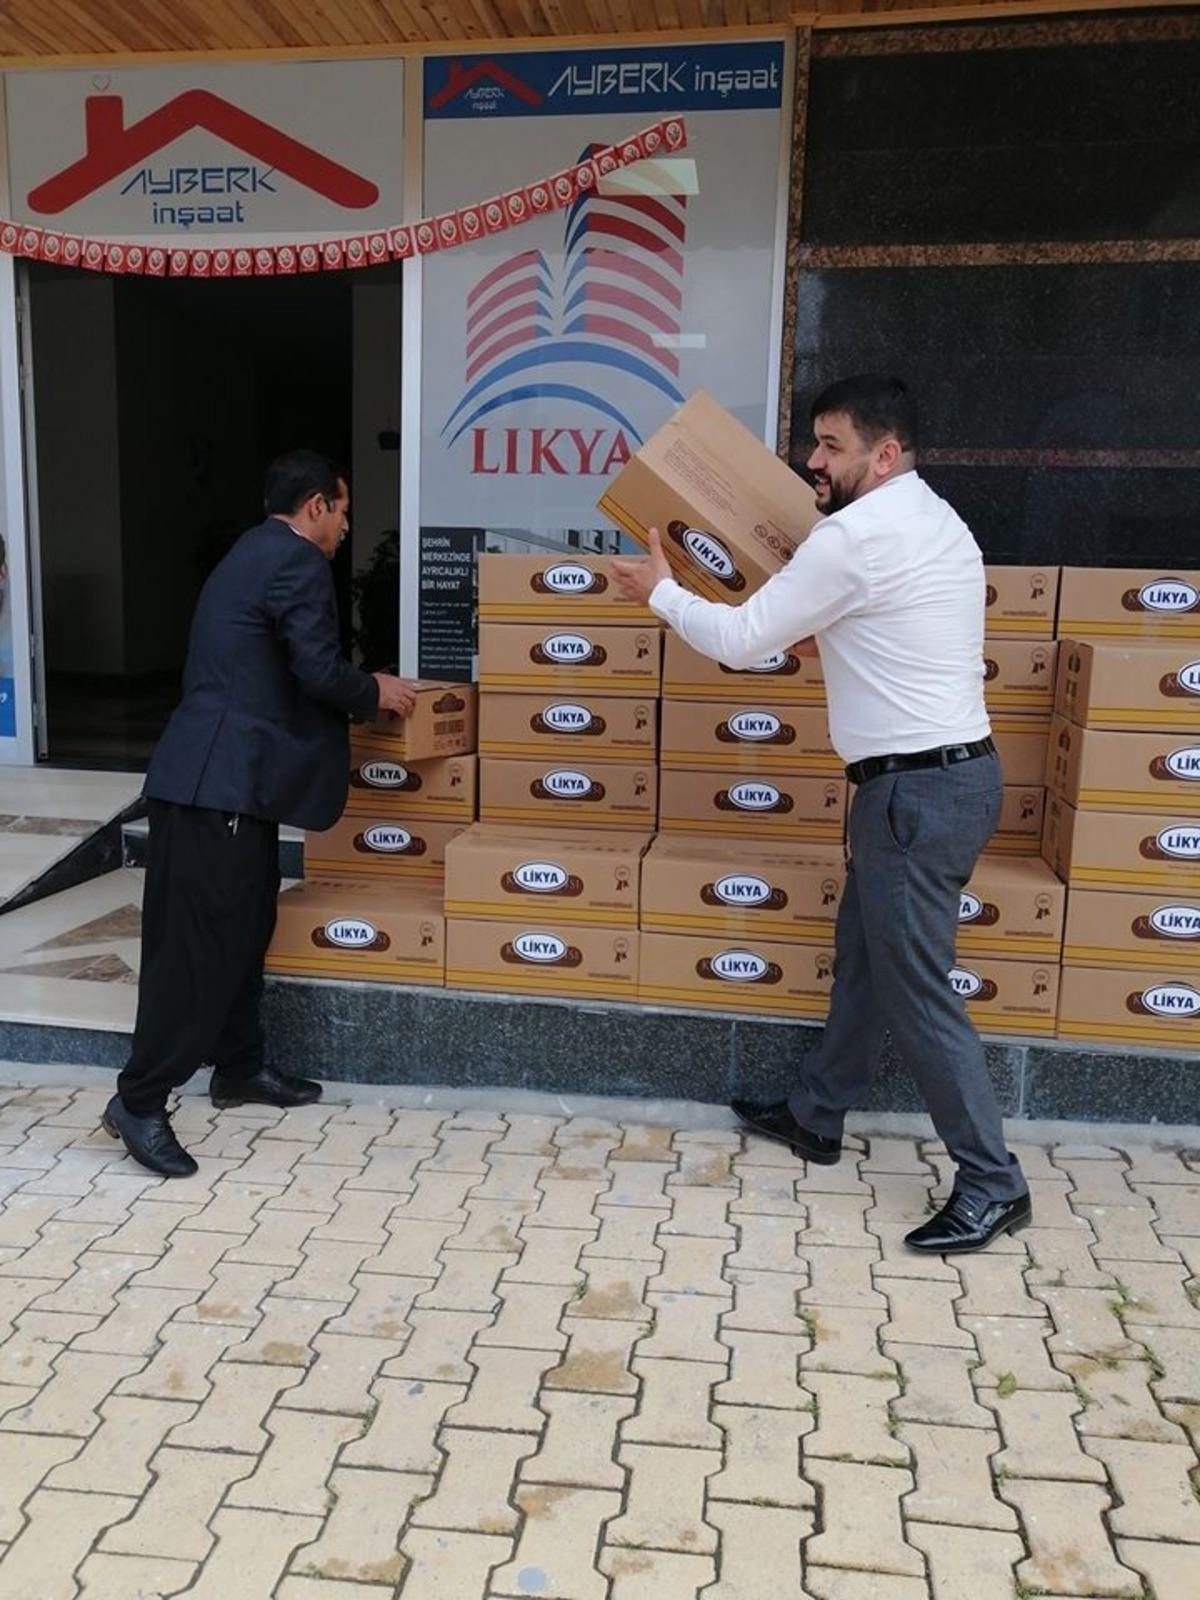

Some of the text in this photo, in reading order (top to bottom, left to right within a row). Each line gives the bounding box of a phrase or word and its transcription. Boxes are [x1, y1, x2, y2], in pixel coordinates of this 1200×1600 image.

[547, 61, 779, 97] AYBERK inşaat
[120, 166, 277, 196] AYBERK
[153, 201, 245, 228] inşaat
[470, 428, 633, 475] LIKYA
[691, 537, 727, 573] LİKYA
[552, 571, 586, 585] LİKYA
[1149, 588, 1189, 604] LİKYA
[551, 639, 585, 655] LİKYA
[552, 711, 585, 724] LİKYA
[737, 717, 773, 732] LİKYA
[1177, 754, 1200, 770] LİK
[369, 764, 401, 780] LİKYA
[552, 777, 585, 790] LİKYA
[737, 788, 773, 802] LİKYA
[372, 828, 405, 845] LİKYA
[1168, 834, 1200, 849] LİKY
[523, 869, 559, 884] LİKYA
[724, 881, 762, 897] LİKYA
[1161, 913, 1200, 929] LİKYA
[333, 922, 368, 940] LİKYA
[522, 939, 558, 954] LİKYA
[721, 957, 759, 973] LİKYA
[1153, 992, 1195, 1009] LİKYA
